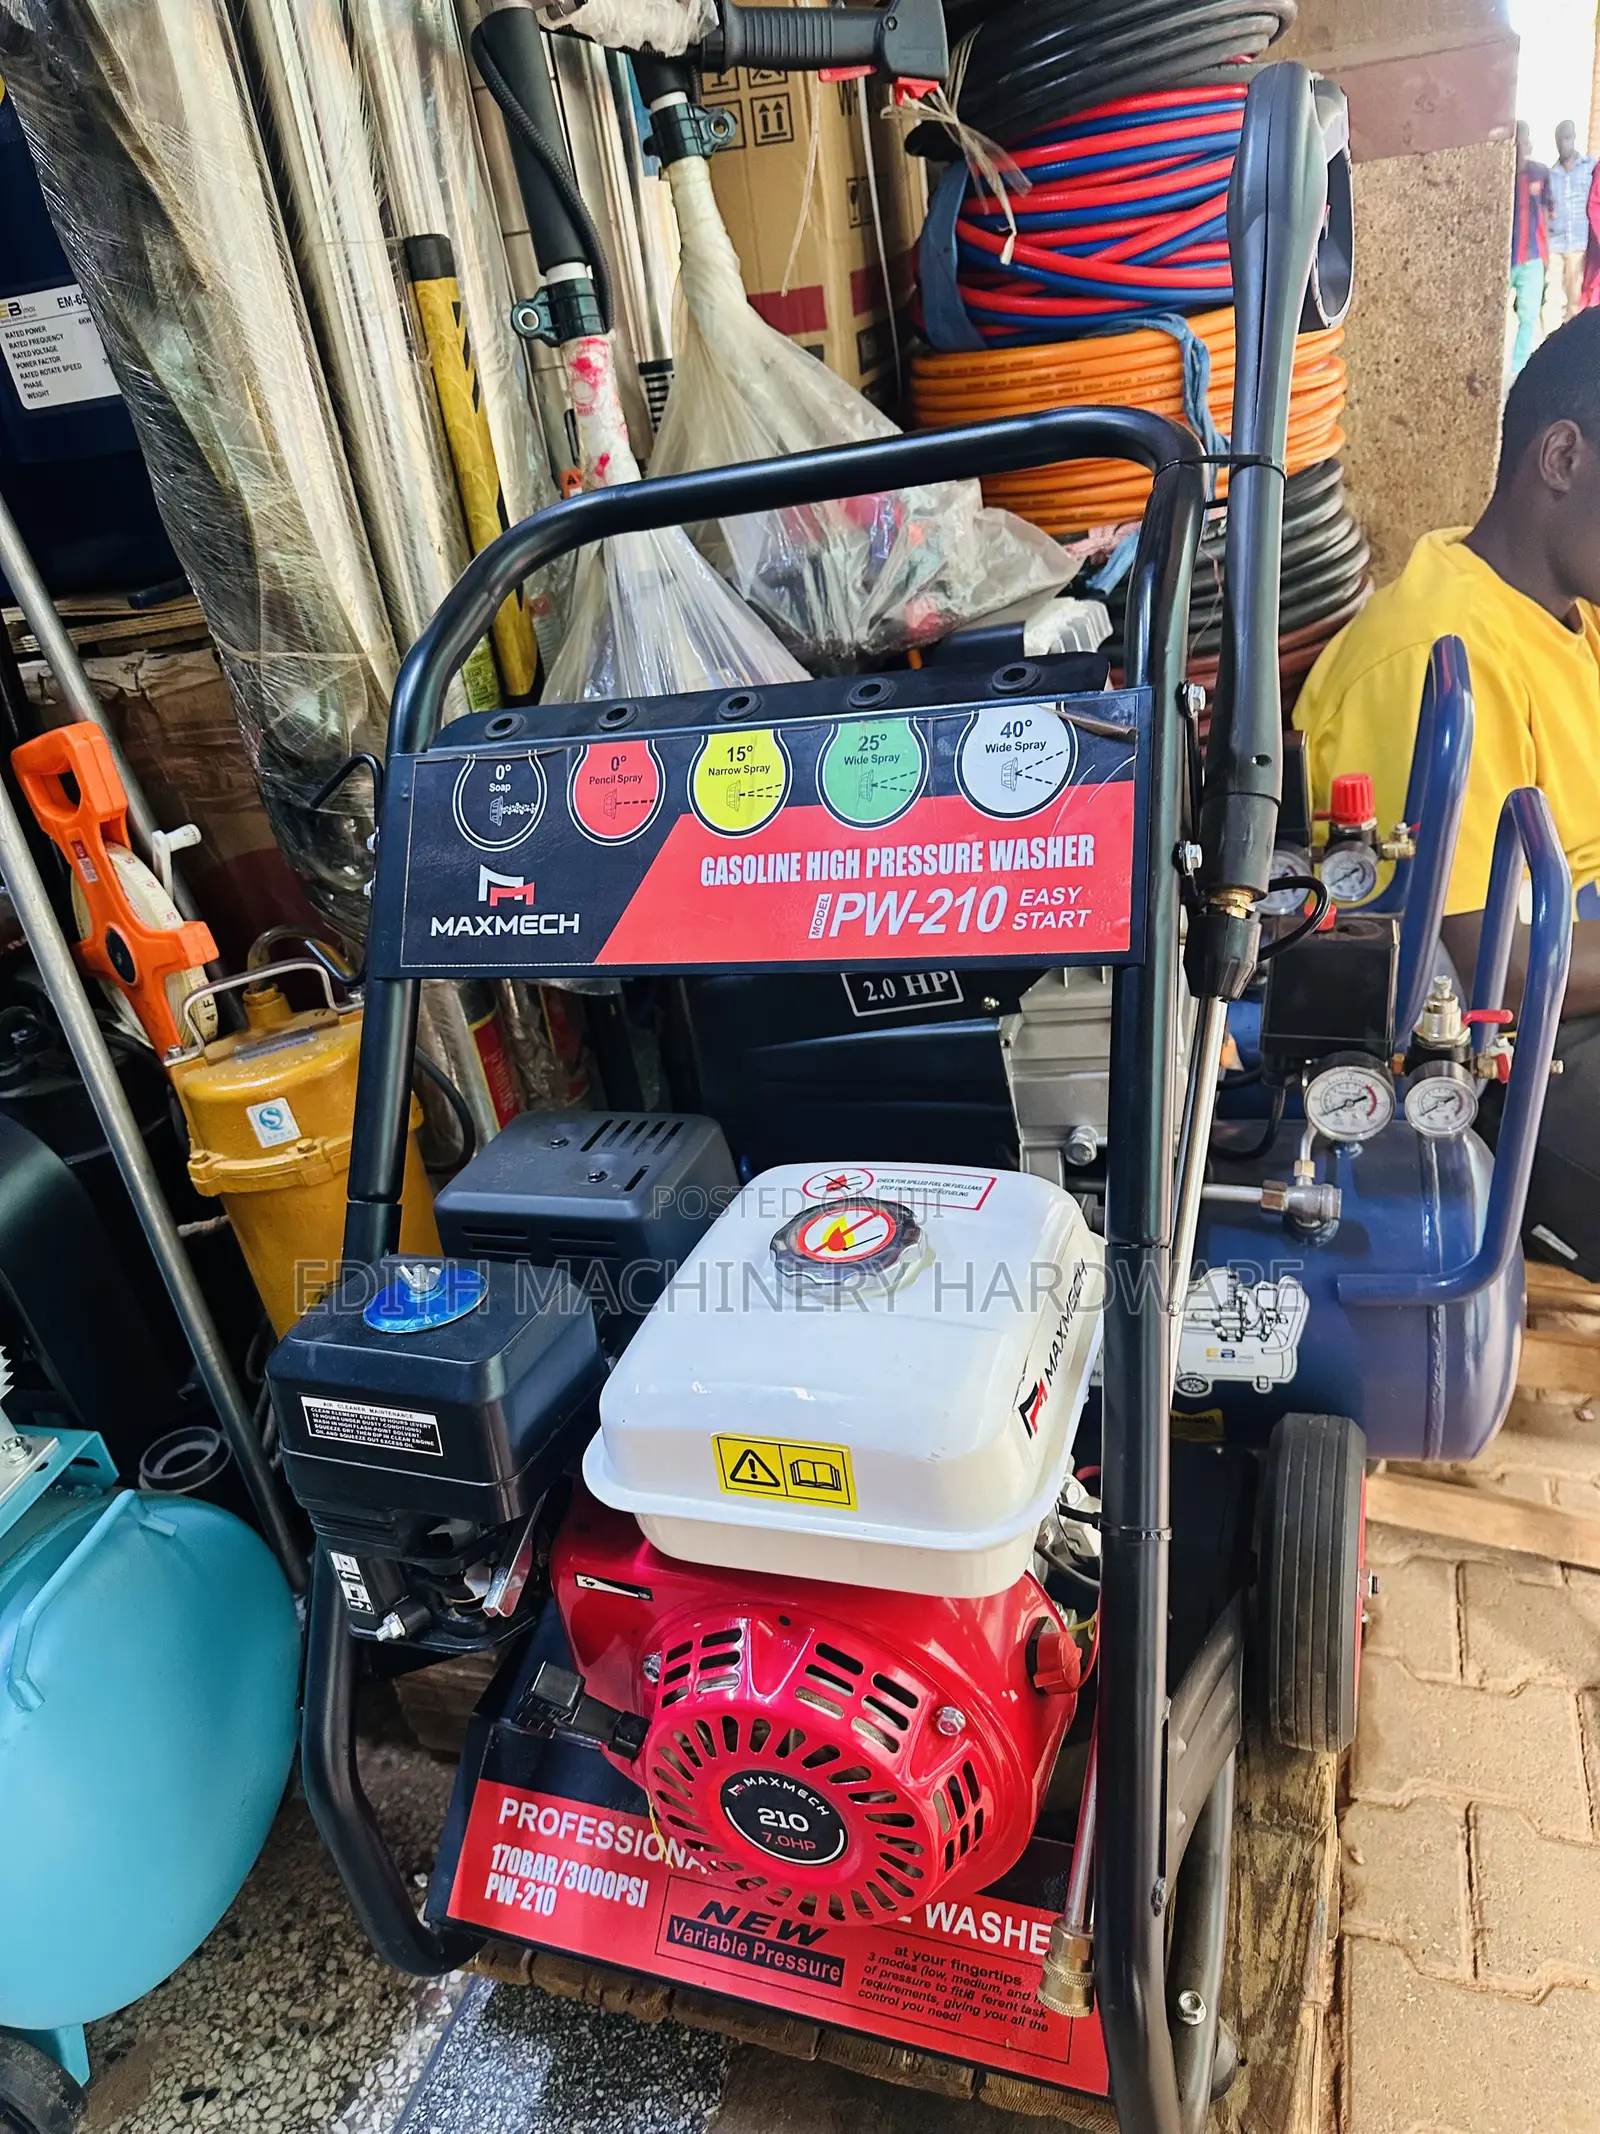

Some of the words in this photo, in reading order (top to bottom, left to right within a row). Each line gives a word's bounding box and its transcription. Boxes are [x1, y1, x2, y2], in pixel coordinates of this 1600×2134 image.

[5, 329, 25, 339] RATED
[25, 325, 47, 336] POWER
[9, 339, 29, 349] RATED
[29, 333, 64, 346] FREQUENCY
[12, 350, 32, 360] RATED
[33, 345, 58, 356] VOLTAGE
[16, 358, 38, 369] POWER
[39, 355, 62, 366] FACTOR
[20, 370, 39, 380] RATED
[40, 366, 61, 376] ROTATE
[62, 362, 82, 372] SPEED
[23, 380, 43, 390] PHASE
[27, 390, 50, 400] WEIGHT
[1000, 719, 1033, 739] 40°
[858, 733, 887, 752] 25°
[985, 741, 1012, 754] Wide
[1014, 739, 1047, 754] Spray
[610, 755, 627, 772] 0°
[727, 745, 754, 763] 15°
[844, 754, 869, 766] Wide
[870, 752, 900, 767] Spray
[495, 764, 512, 781] 0°
[589, 774, 615, 786] Pencil
[617, 772, 643, 786] Spray
[708, 765, 742, 777] Narrow
[743, 762, 771, 777] Spray
[489, 782, 512, 795] Soap
[701, 851, 802, 887] GASOLINE
[806, 848, 858, 882] HIGH
[865, 841, 984, 879] PRESSURE
[989, 834, 1095, 872] WASHER
[1019, 885, 1083, 908] EASY
[811, 895, 830, 937] MODEL
[829, 885, 1008, 937] PW-210
[1011, 909, 1092, 931] START
[430, 913, 580, 937] MAXMECH
[863, 978, 897, 1002] 2.0
[903, 970, 950, 997] HP
[1044, 1258, 1087, 1386] MAXMECH
[320, 1413, 340, 1421] HOURS
[331, 1410, 358, 1418] ELEMENT
[387, 1418, 408, 1426] HOURS
[337, 1404, 366, 1412] CLEANER
[369, 1409, 414, 1419] MAINTENANCE
[314, 1423, 341, 1432] SQUEEZE
[391, 1434, 411, 1442] CLEAN
[411, 1438, 435, 1447] ENGINE
[339, 1432, 366, 1441] SQUEEZE
[380, 1439, 403, 1447] EXCESS
[743, 1776, 830, 1816] MAXMECH
[757, 1807, 809, 1832] 210
[498, 1797, 712, 1876] PROFESSIONA
[491, 1843, 650, 1909] 170BAR/3000PSI
[484, 1873, 559, 1916] PW-210
[697, 1900, 829, 1947] NEW
[673, 1919, 748, 1957] Variable
[752, 1941, 841, 1982] Pressure
[868, 1952, 876, 1961] 3
[878, 1955, 917, 1973] modes
[920, 1965, 948, 1982] (low,
[1006, 1989, 1031, 2001] and
[894, 1946, 909, 1957] at
[912, 1952, 947, 1967] your
[950, 1958, 1022, 1986] fingertips
[864, 1963, 877, 1974] of
[879, 1967, 932, 1990] pressure
[935, 1981, 947, 1993] to
[981, 1993, 1018, 2012] ferent
[1021, 2004, 1047, 2019] task
[858, 1988, 899, 2006] control
[901, 2000, 925, 2014] you
[927, 2007, 962, 2023] need!
[860, 1976, 940, 2006] requirements,
[943, 1998, 981, 2016] giving
[984, 2009, 1008, 2023] you
[1011, 2014, 1026, 2027] all
[1029, 2020, 1049, 2033] the
